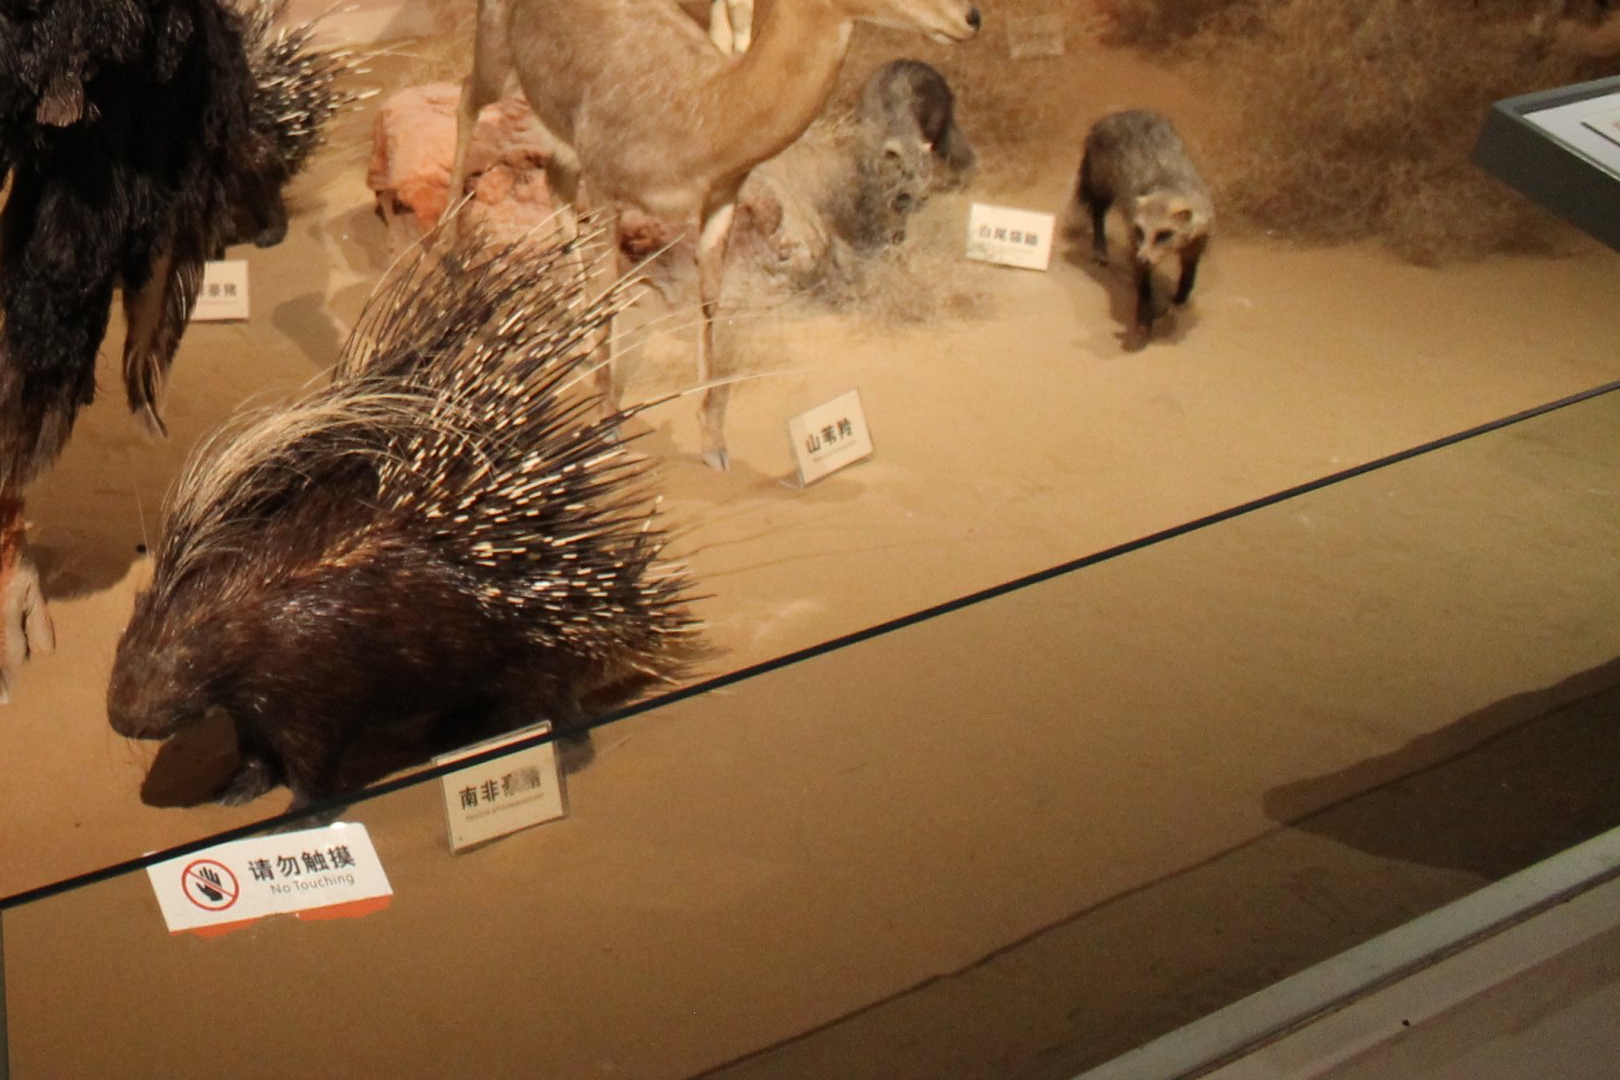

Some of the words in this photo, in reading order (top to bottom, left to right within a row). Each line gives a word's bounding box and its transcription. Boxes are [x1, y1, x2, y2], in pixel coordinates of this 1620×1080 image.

[248, 845, 356, 881] 请勿触摸
[270, 883, 291, 896] No
[293, 873, 356, 892] Touching
